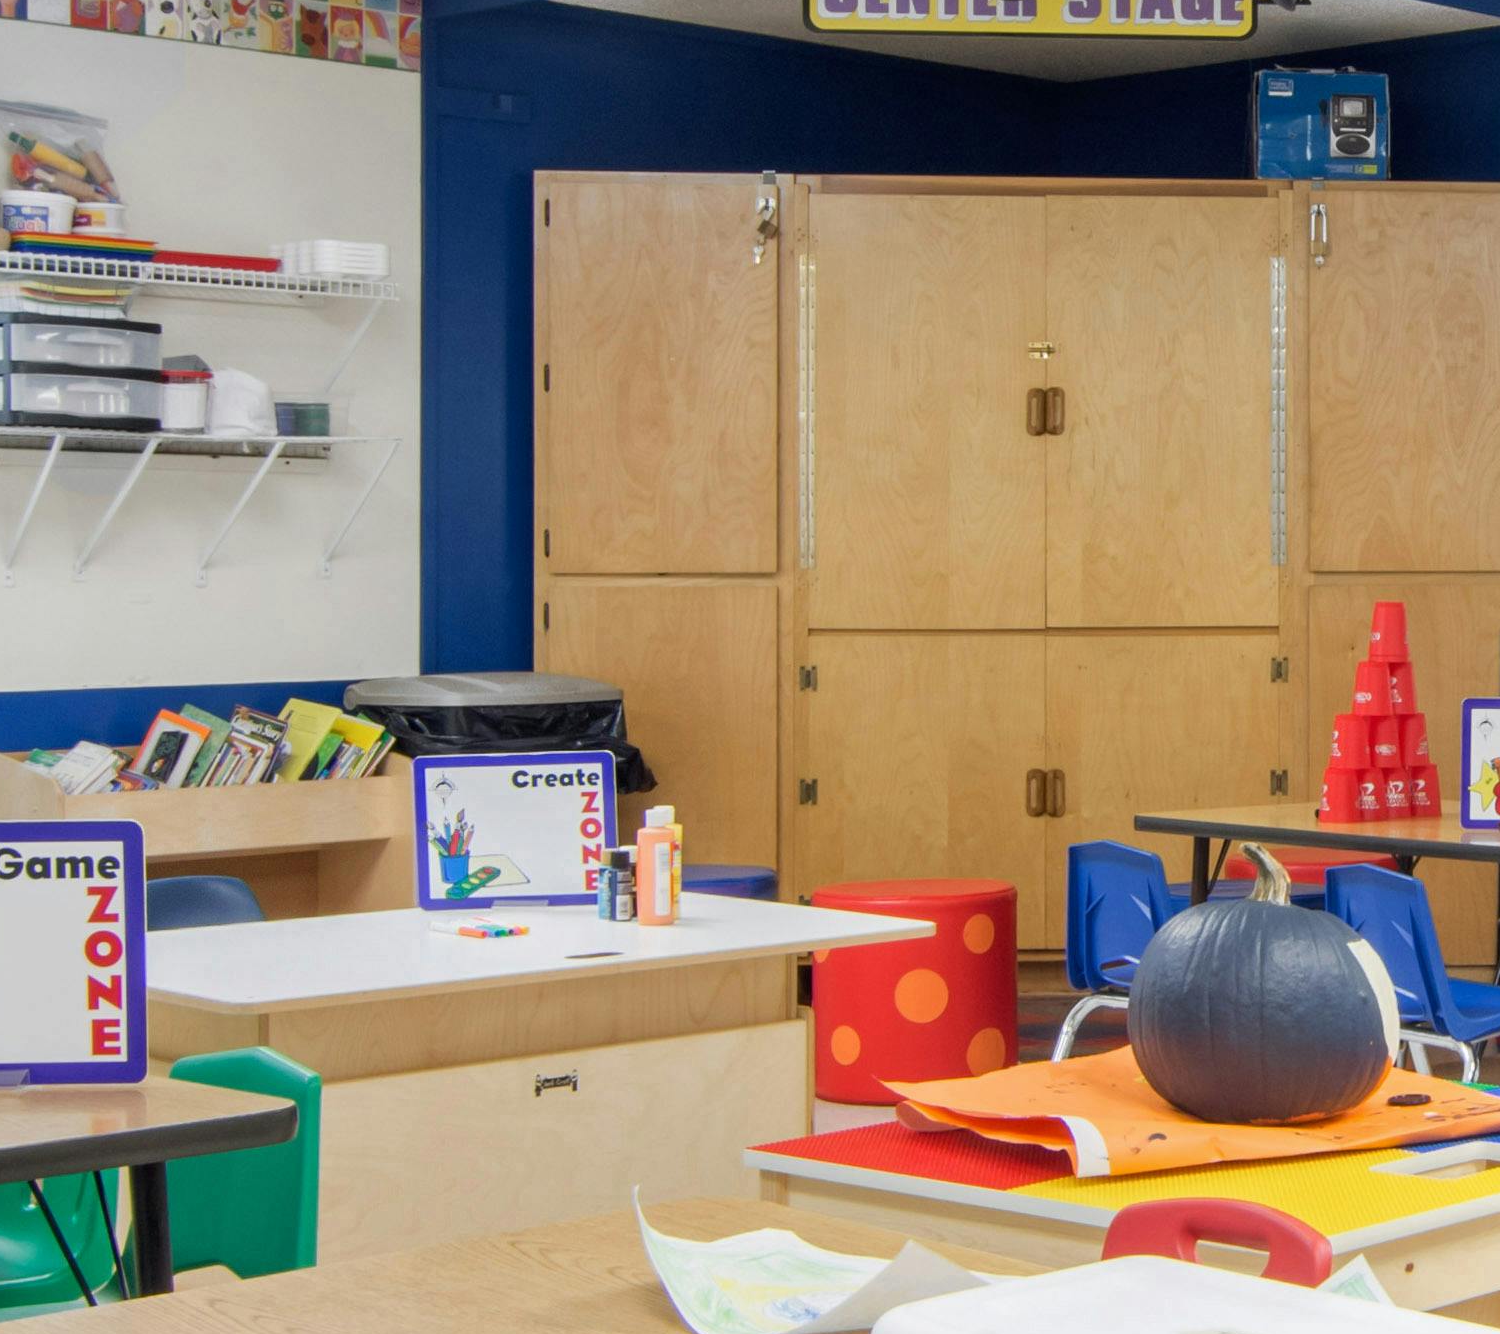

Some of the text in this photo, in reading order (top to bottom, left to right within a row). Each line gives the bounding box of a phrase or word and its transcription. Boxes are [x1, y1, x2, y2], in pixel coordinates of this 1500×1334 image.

[512, 770, 599, 787] Create
[580, 792, 601, 890] ZONE
[85, 886, 122, 1056] ZONE
